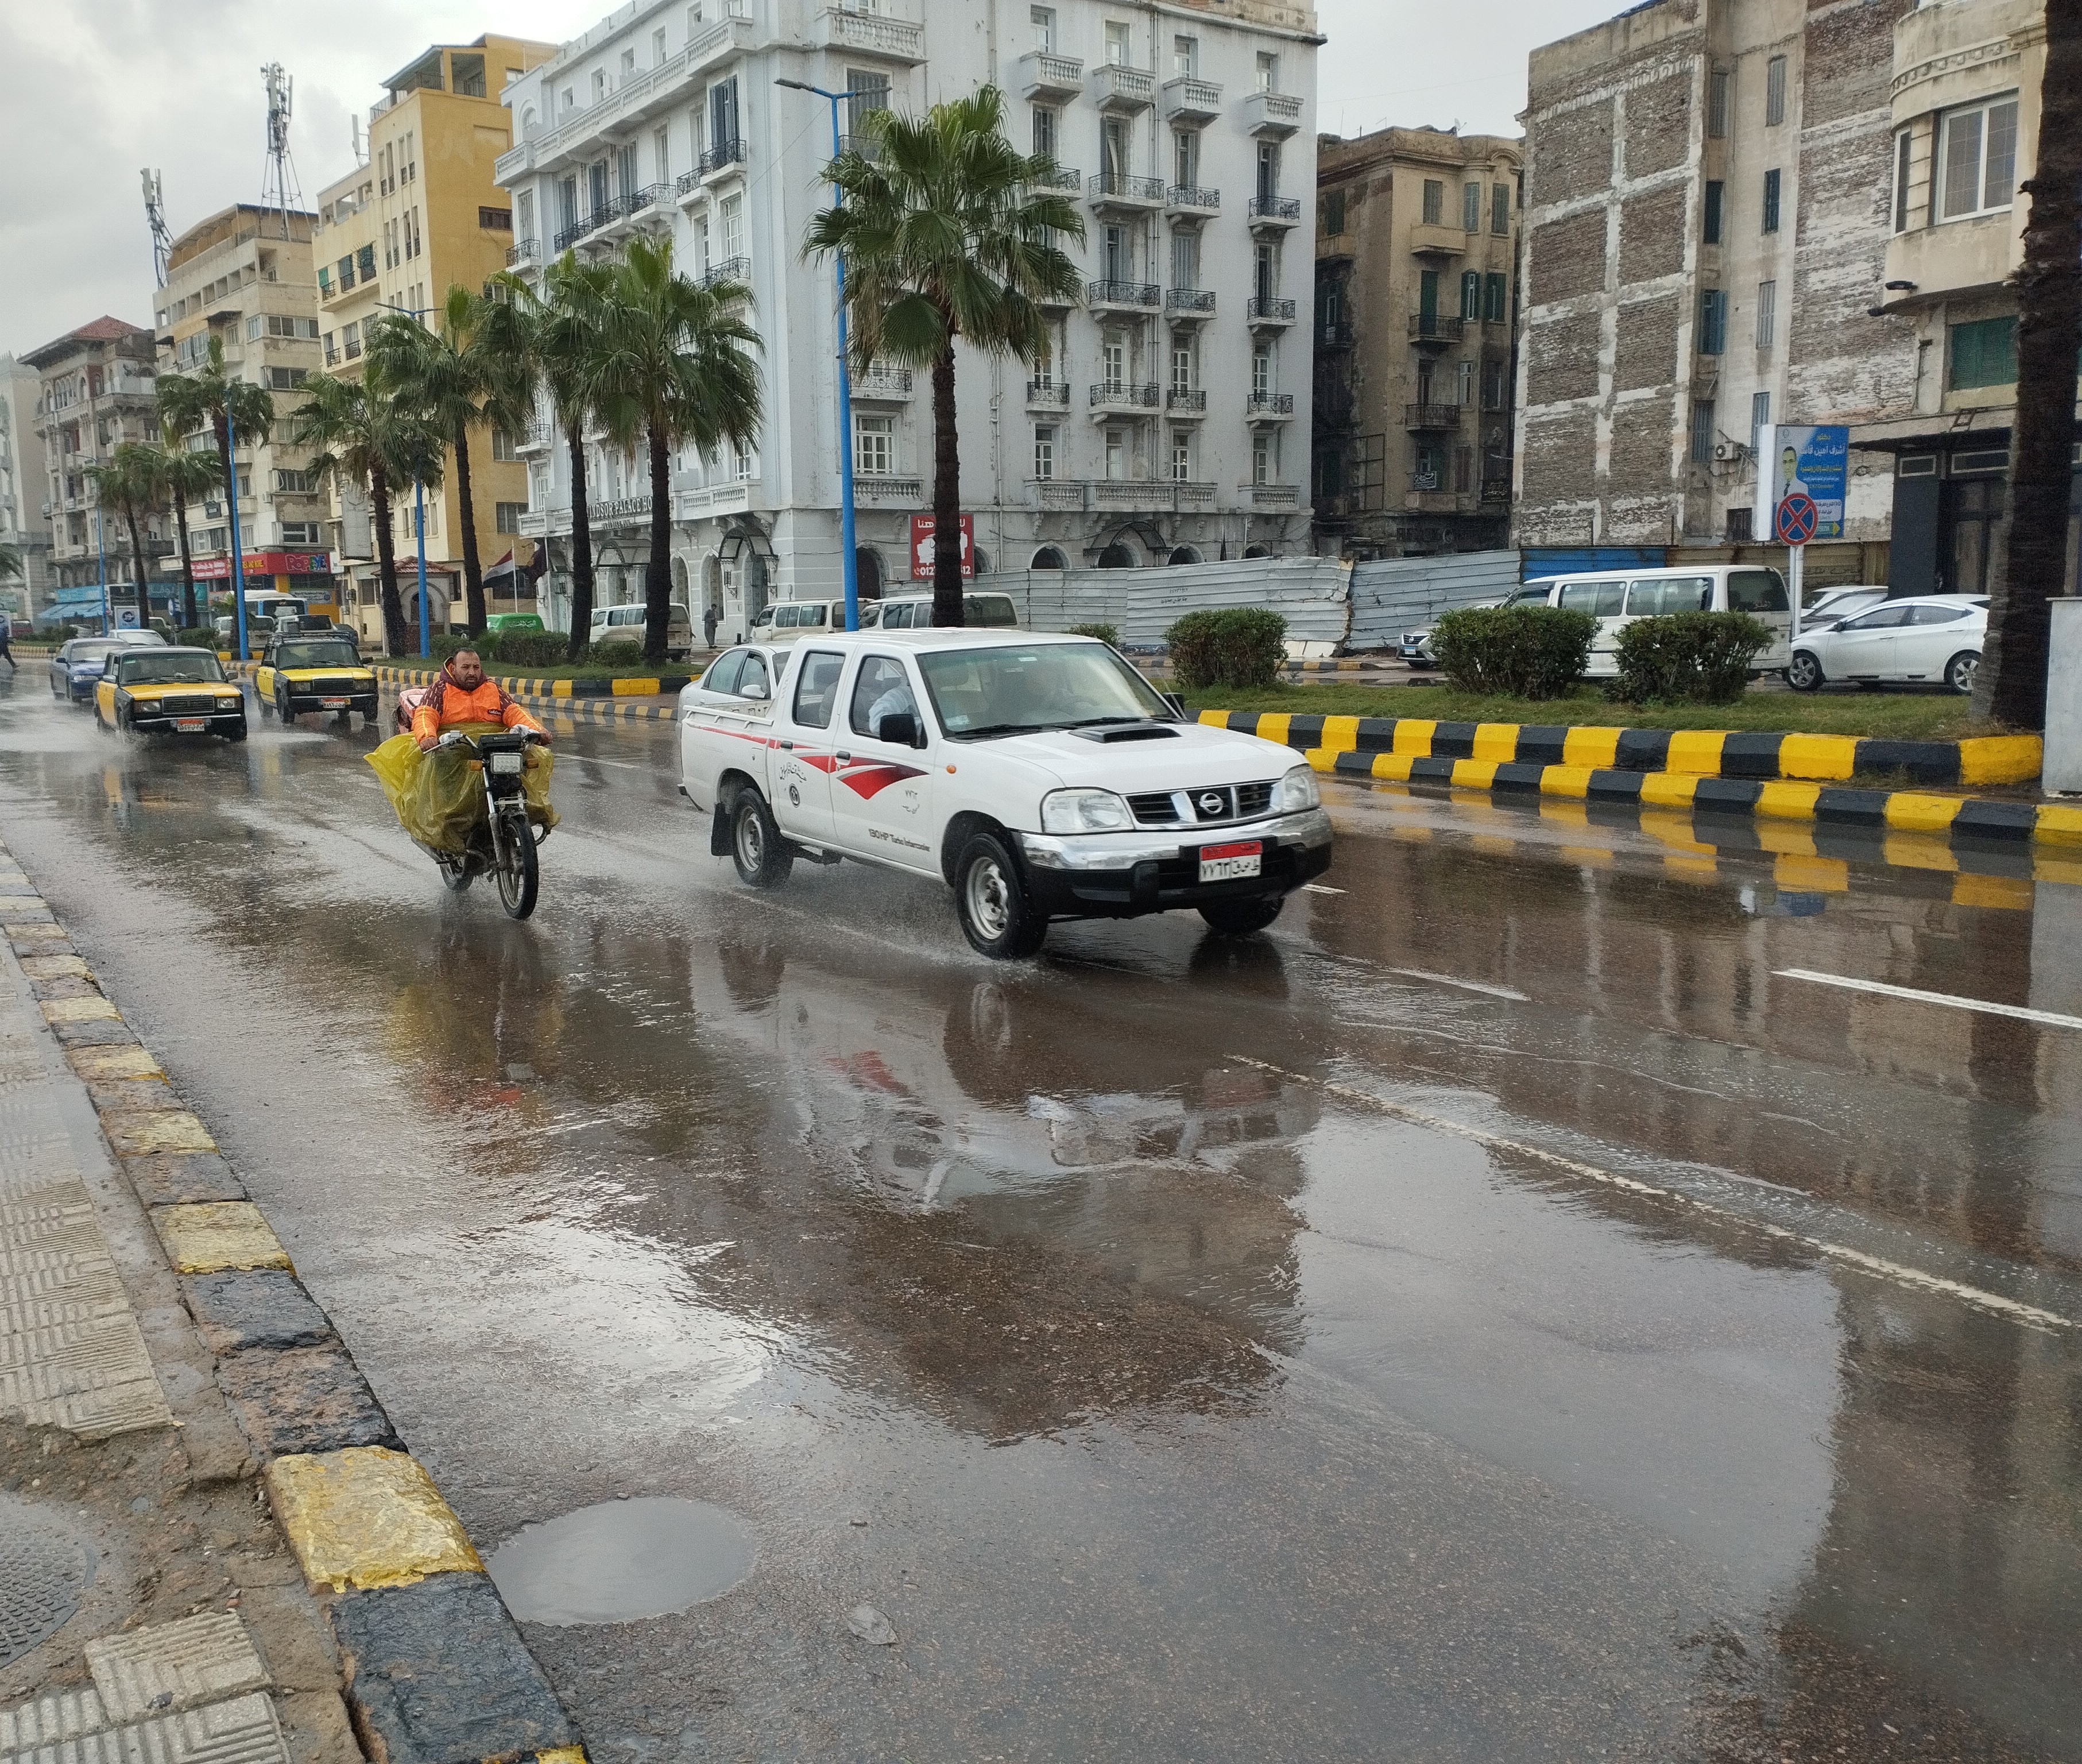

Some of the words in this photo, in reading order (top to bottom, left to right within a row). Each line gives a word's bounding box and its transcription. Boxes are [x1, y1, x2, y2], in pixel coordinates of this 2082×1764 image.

[587, 501, 613, 518] INDSOR
[614, 498, 641, 515] PALACE
[918, 519, 934, 528] هنا
